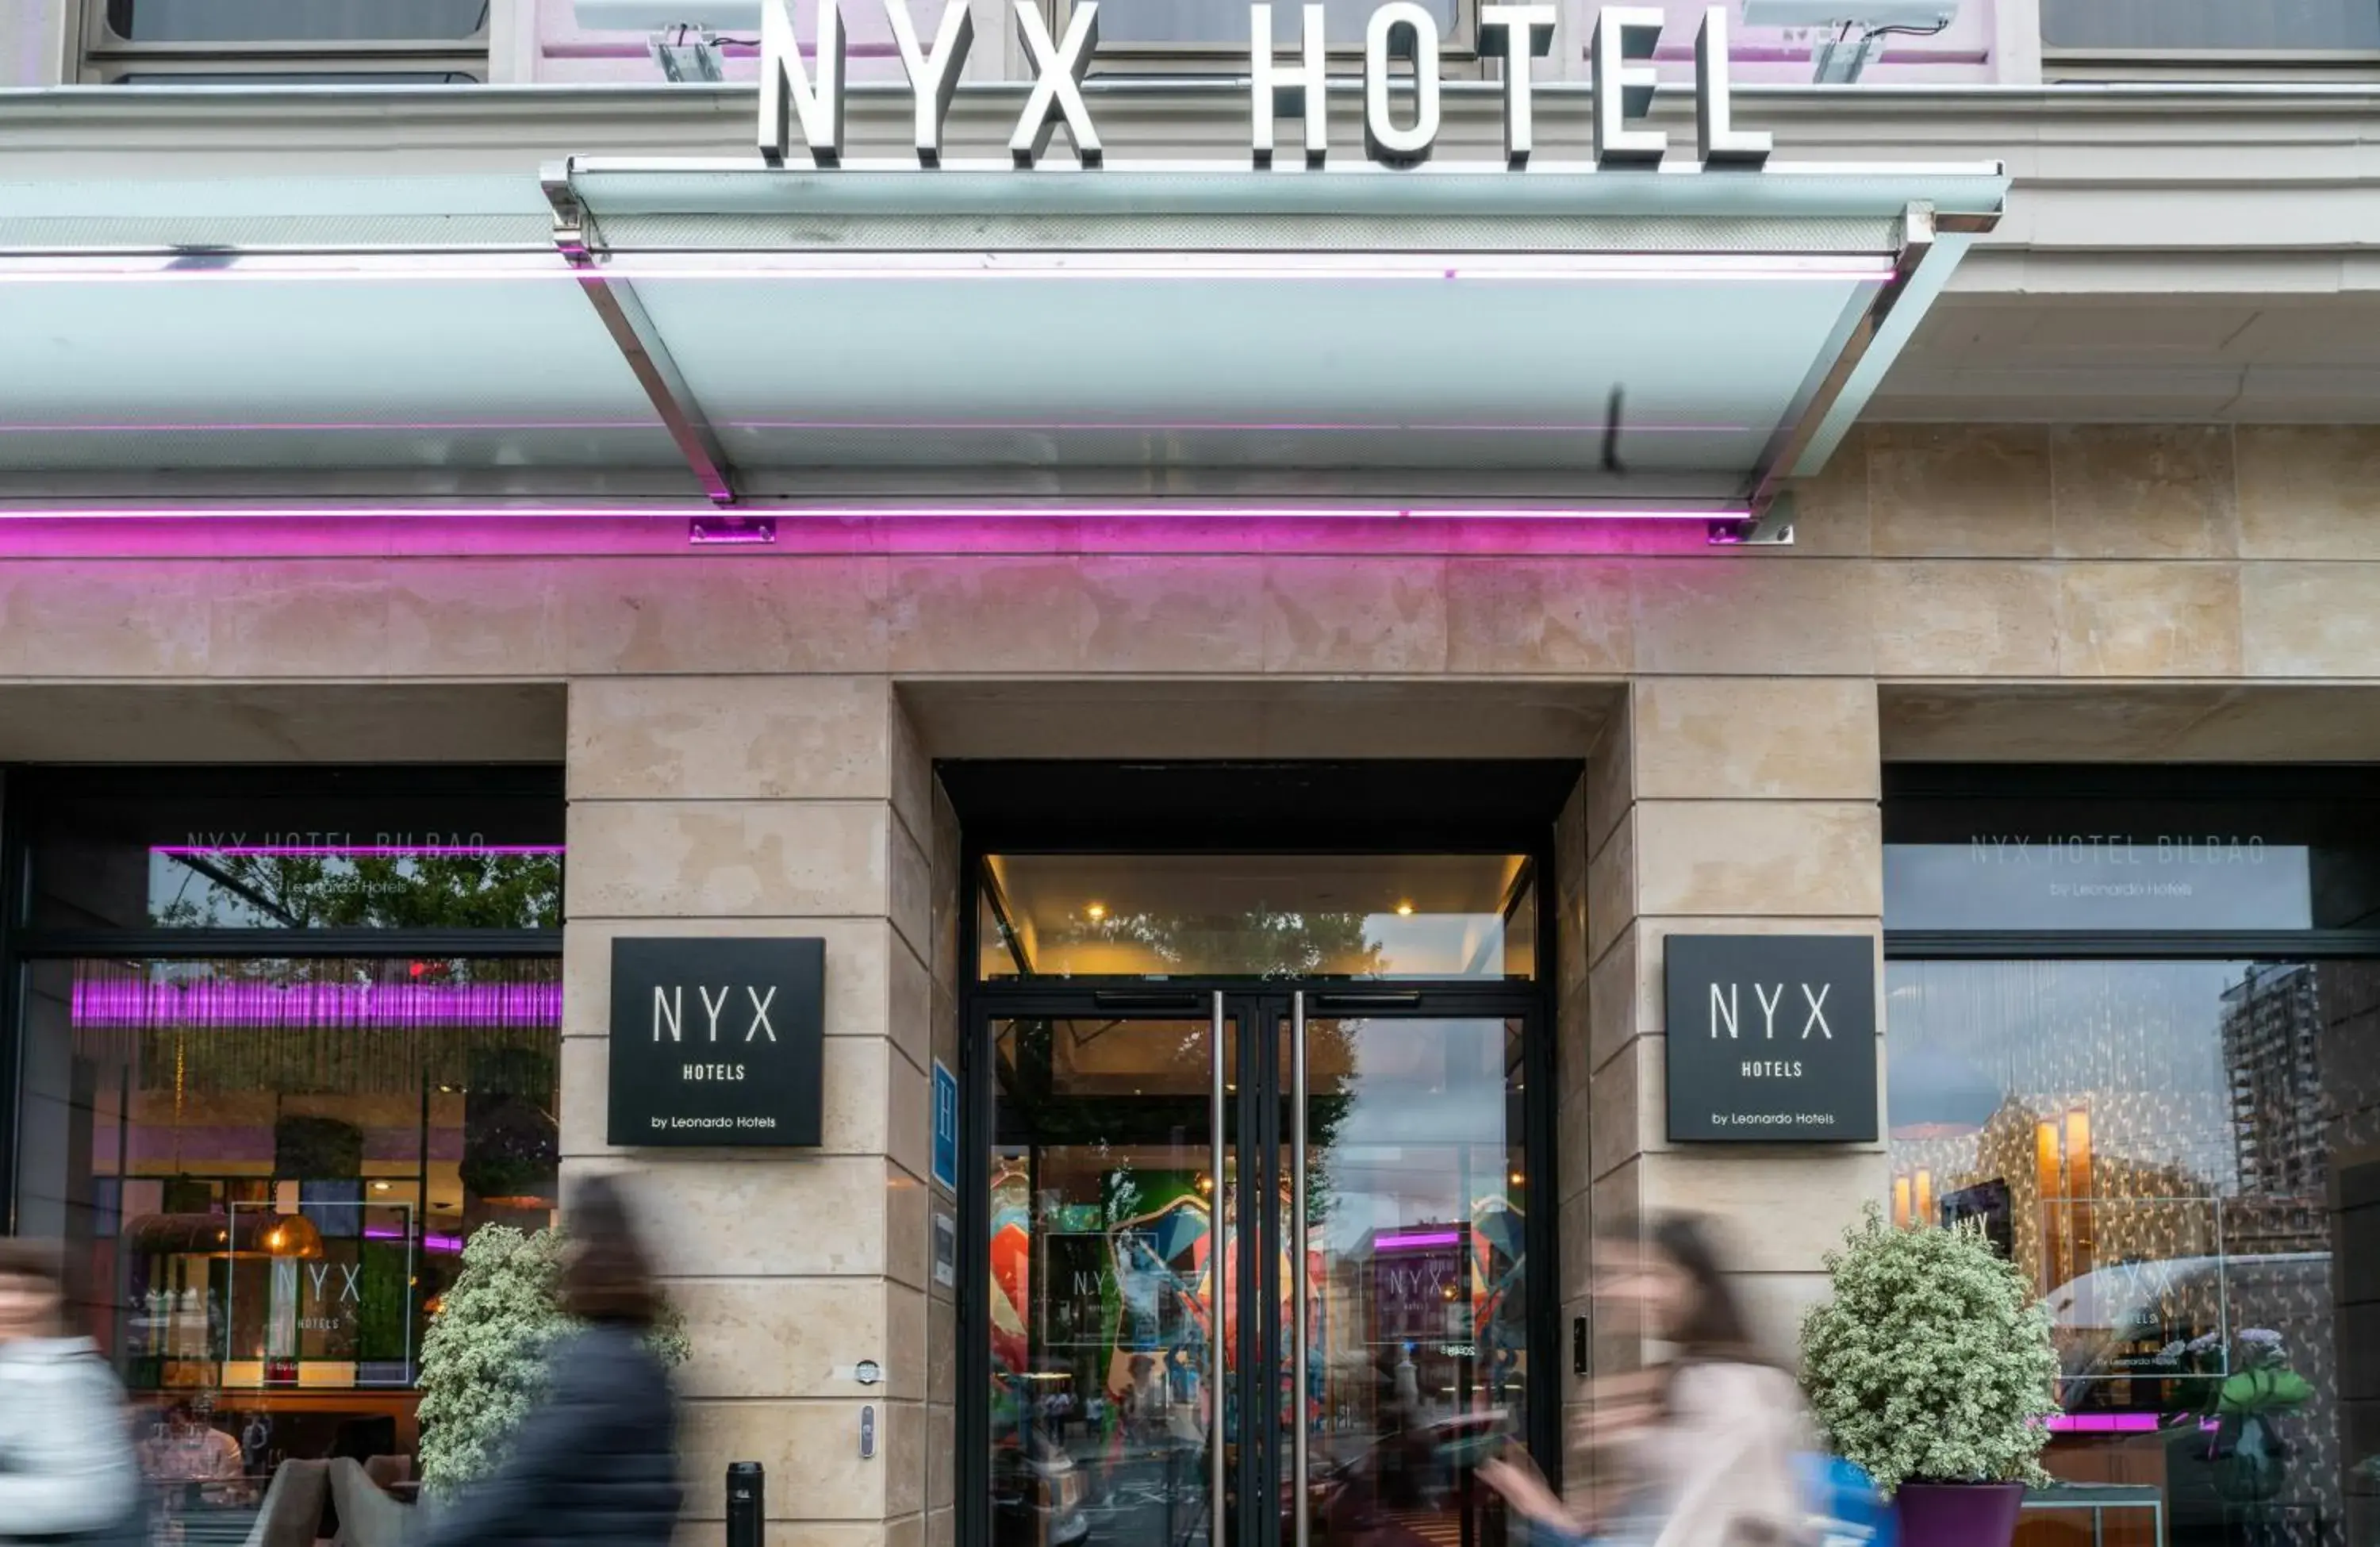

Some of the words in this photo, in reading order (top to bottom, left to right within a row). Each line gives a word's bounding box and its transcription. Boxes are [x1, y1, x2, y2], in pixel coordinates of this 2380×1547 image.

[758, 0, 1103, 168] NYX
[1250, 2, 1773, 170] HOTEL
[1971, 835, 2032, 865] NYX
[2047, 835, 2141, 865] HOTEL
[2157, 835, 2265, 865] BILBAO
[653, 985, 777, 1042] NYX
[1710, 982, 1833, 1038] NYX
[682, 1064, 746, 1080] HOTELS
[1741, 1061, 1802, 1077] HOTELS
[651, 1116, 667, 1130] by
[671, 1116, 733, 1127] Leonardo
[737, 1116, 776, 1127] Hotels
[1711, 1113, 1727, 1125] by
[1732, 1113, 1792, 1124] Leonardo
[1795, 1113, 1835, 1124] Hotels
[278, 1263, 360, 1301] NYX
[1391, 1269, 1441, 1296] NYX
[298, 1319, 340, 1329] HOTELS
